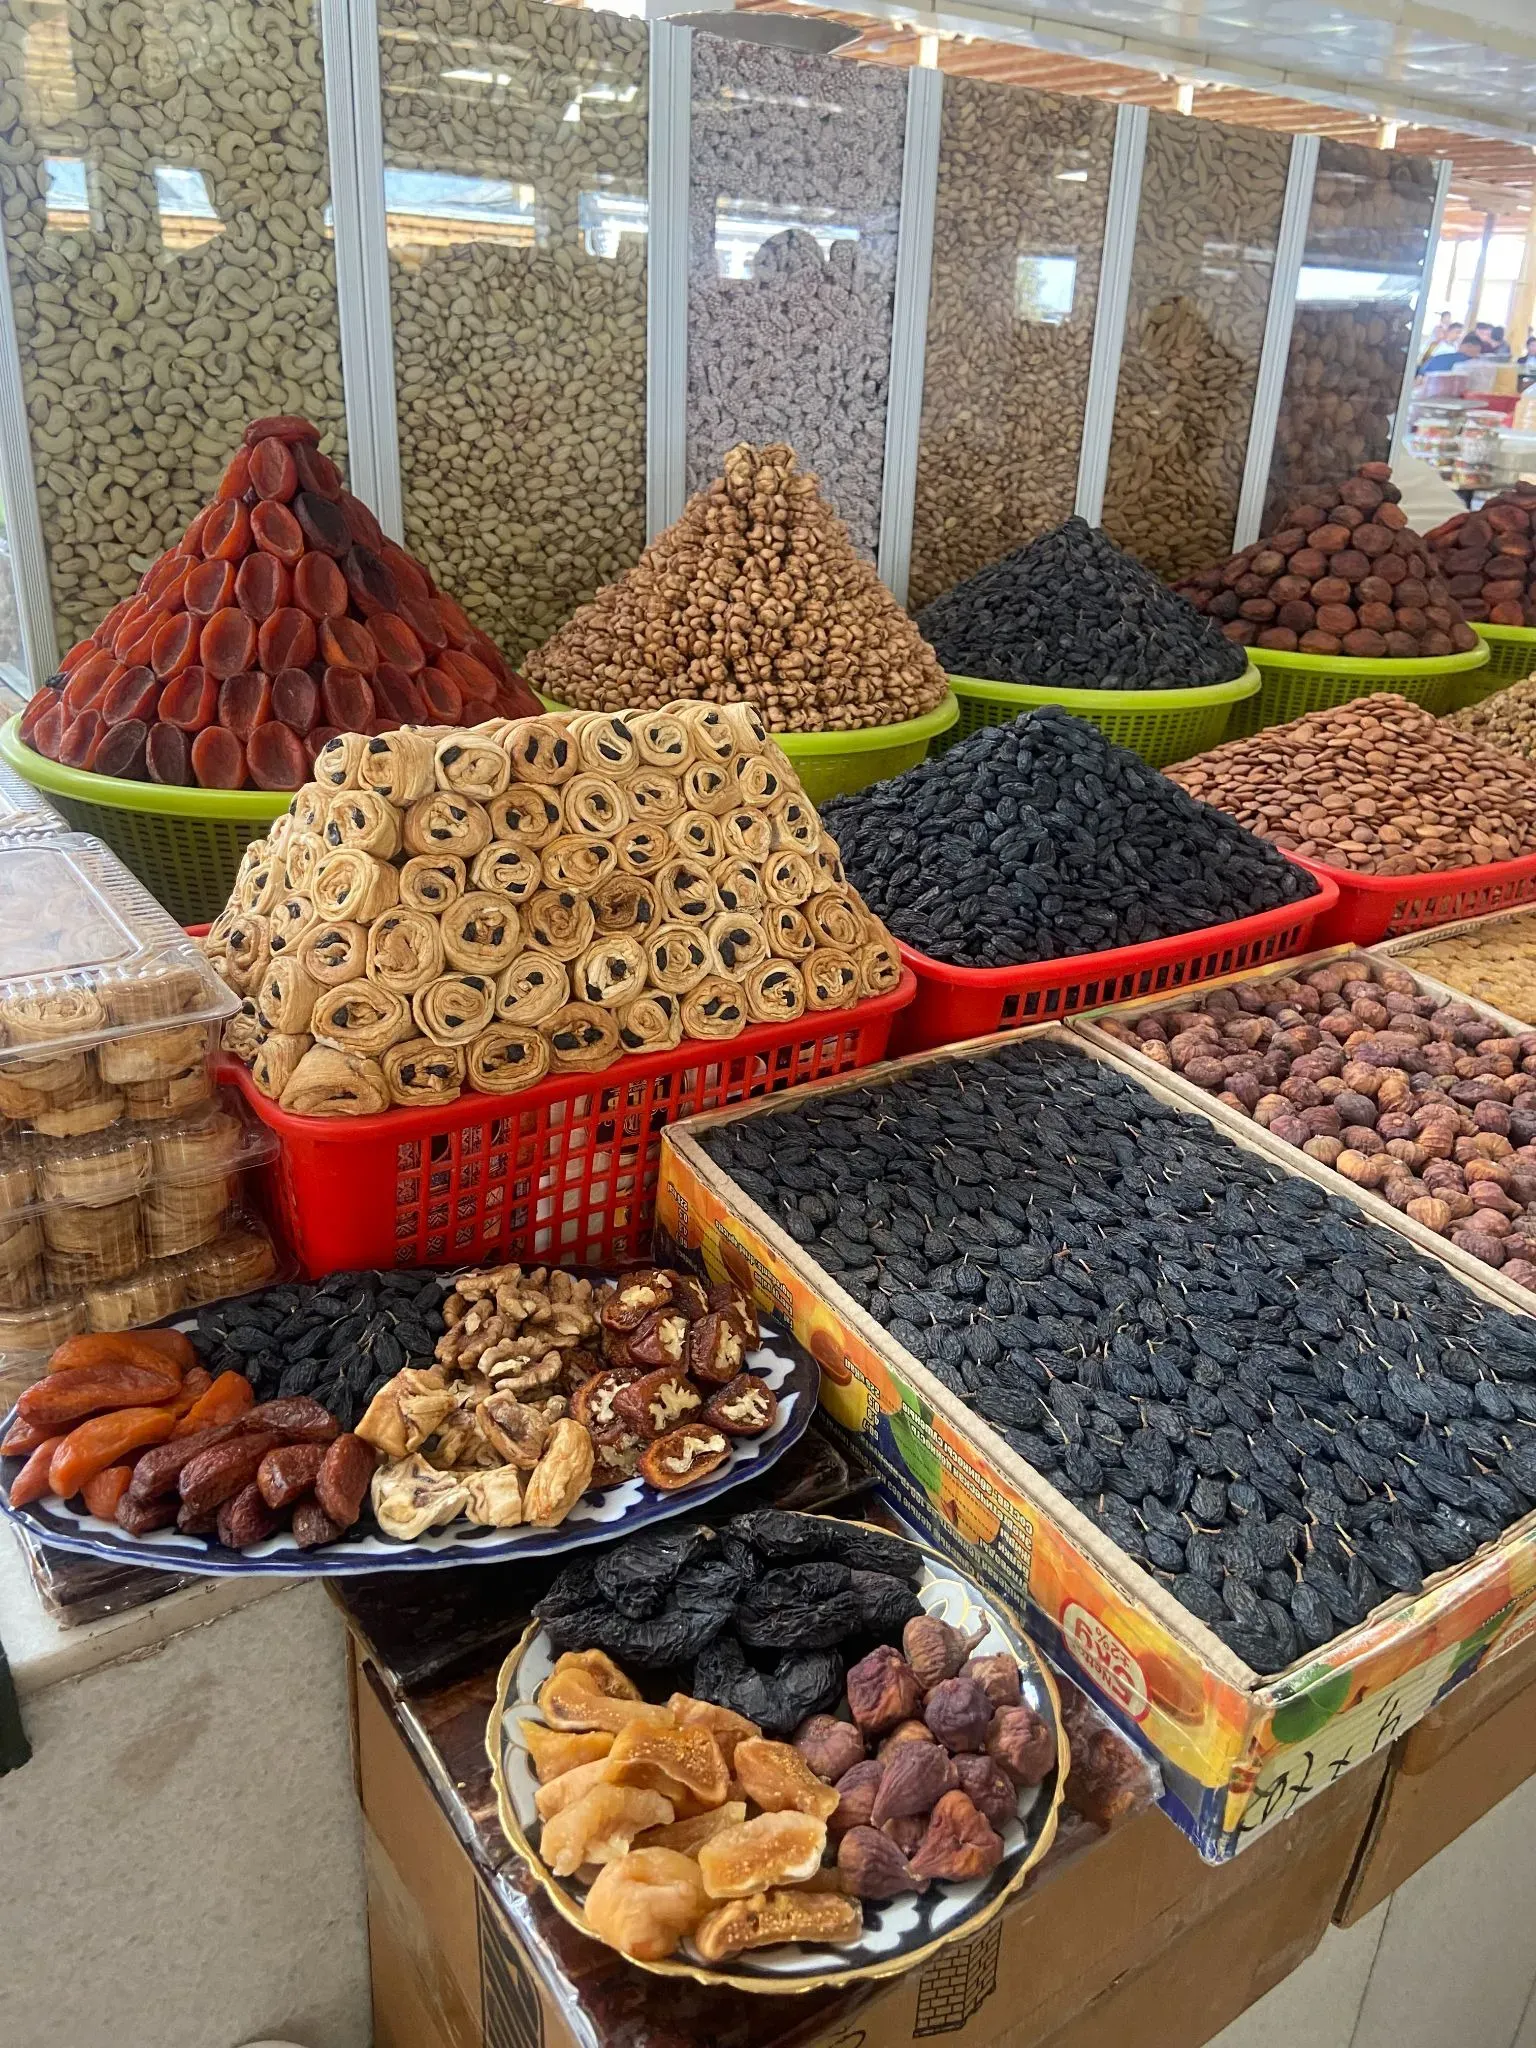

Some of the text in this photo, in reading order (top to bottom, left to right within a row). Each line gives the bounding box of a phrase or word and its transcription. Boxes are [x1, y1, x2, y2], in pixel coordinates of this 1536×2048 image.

[901, 1399, 943, 1449] сушеные
[910, 1422, 952, 1472] ценность
[887, 1479, 901, 1502] без
[944, 1440, 992, 1497] абрикосы
[902, 1495, 931, 1532] целые
[910, 1485, 925, 1509] 100
[952, 1463, 1032, 1551] Энергетическая
[993, 1488, 1032, 1536] Состав:
[939, 1516, 980, 1565] ценность
[978, 1534, 1028, 1594] Углеводы
[997, 1538, 1029, 1579] Белки
[999, 1526, 1030, 1566] Жиры
[981, 1557, 1026, 1612] Пищевая
